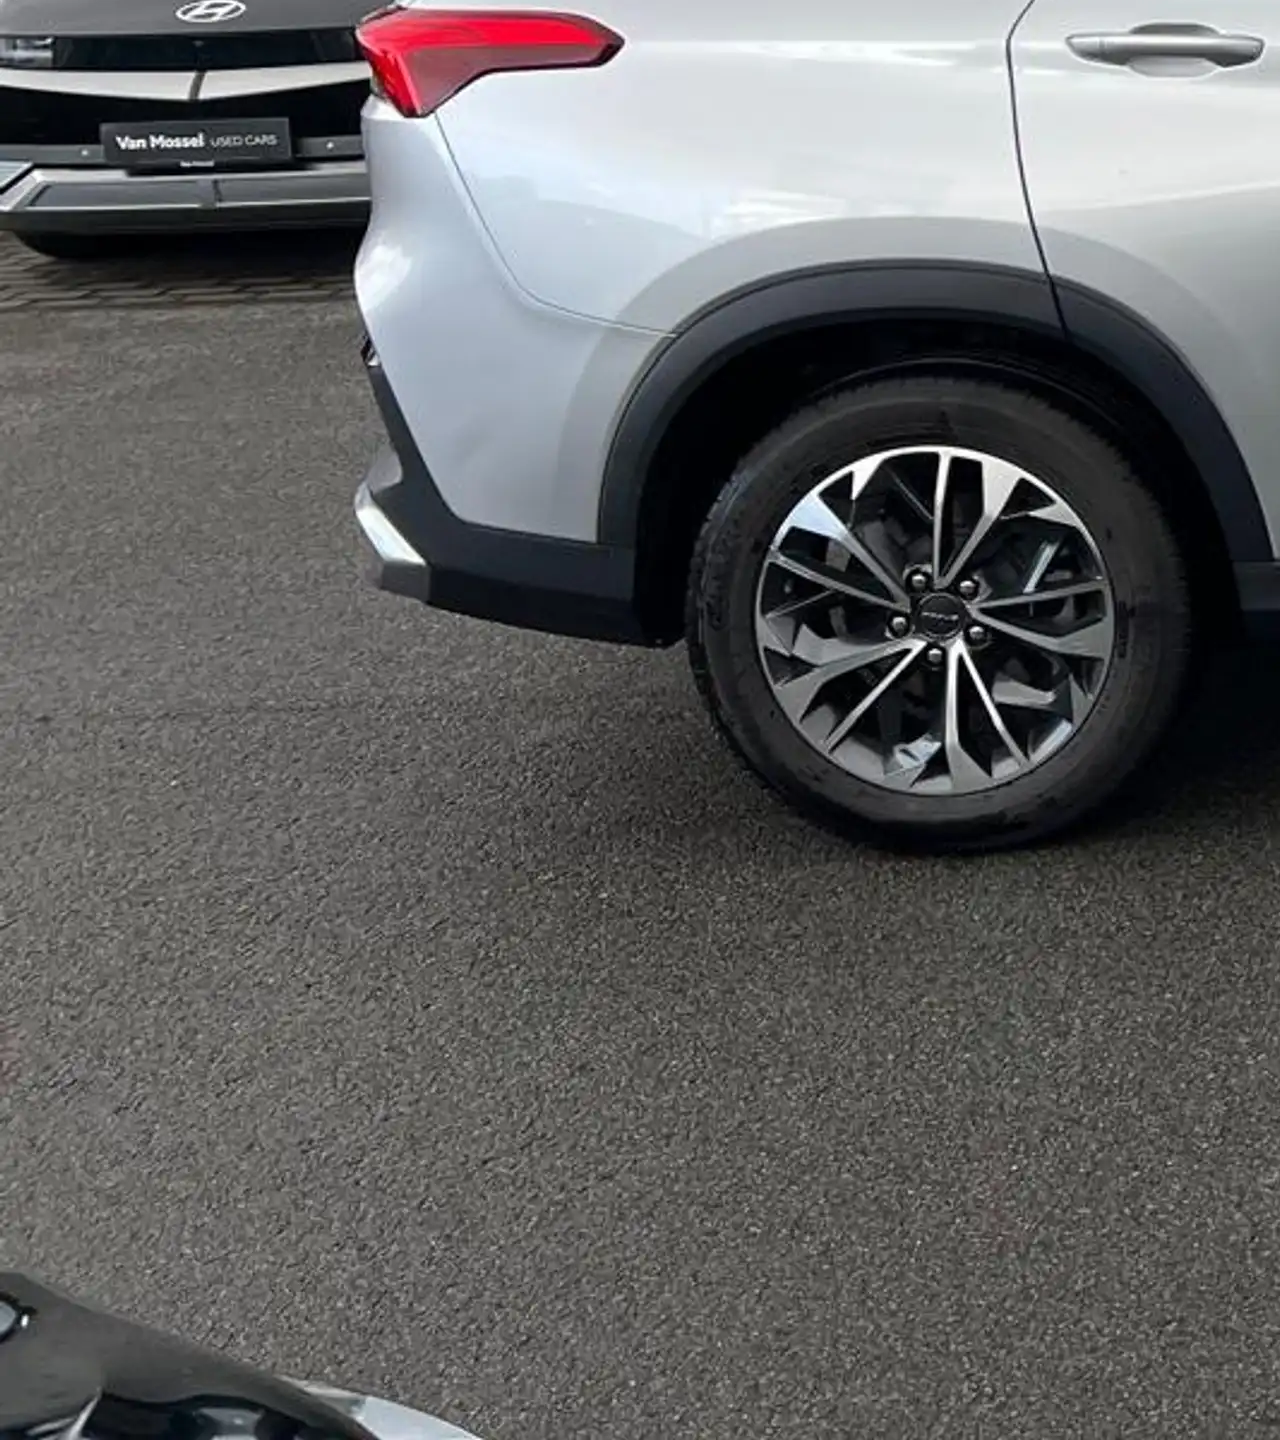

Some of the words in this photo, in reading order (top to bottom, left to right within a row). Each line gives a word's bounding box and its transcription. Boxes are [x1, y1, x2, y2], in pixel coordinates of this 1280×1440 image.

[116, 134, 147, 151] Van
[150, 132, 205, 149] Mossel
[210, 135, 243, 148] USED
[245, 134, 278, 146] CARS
